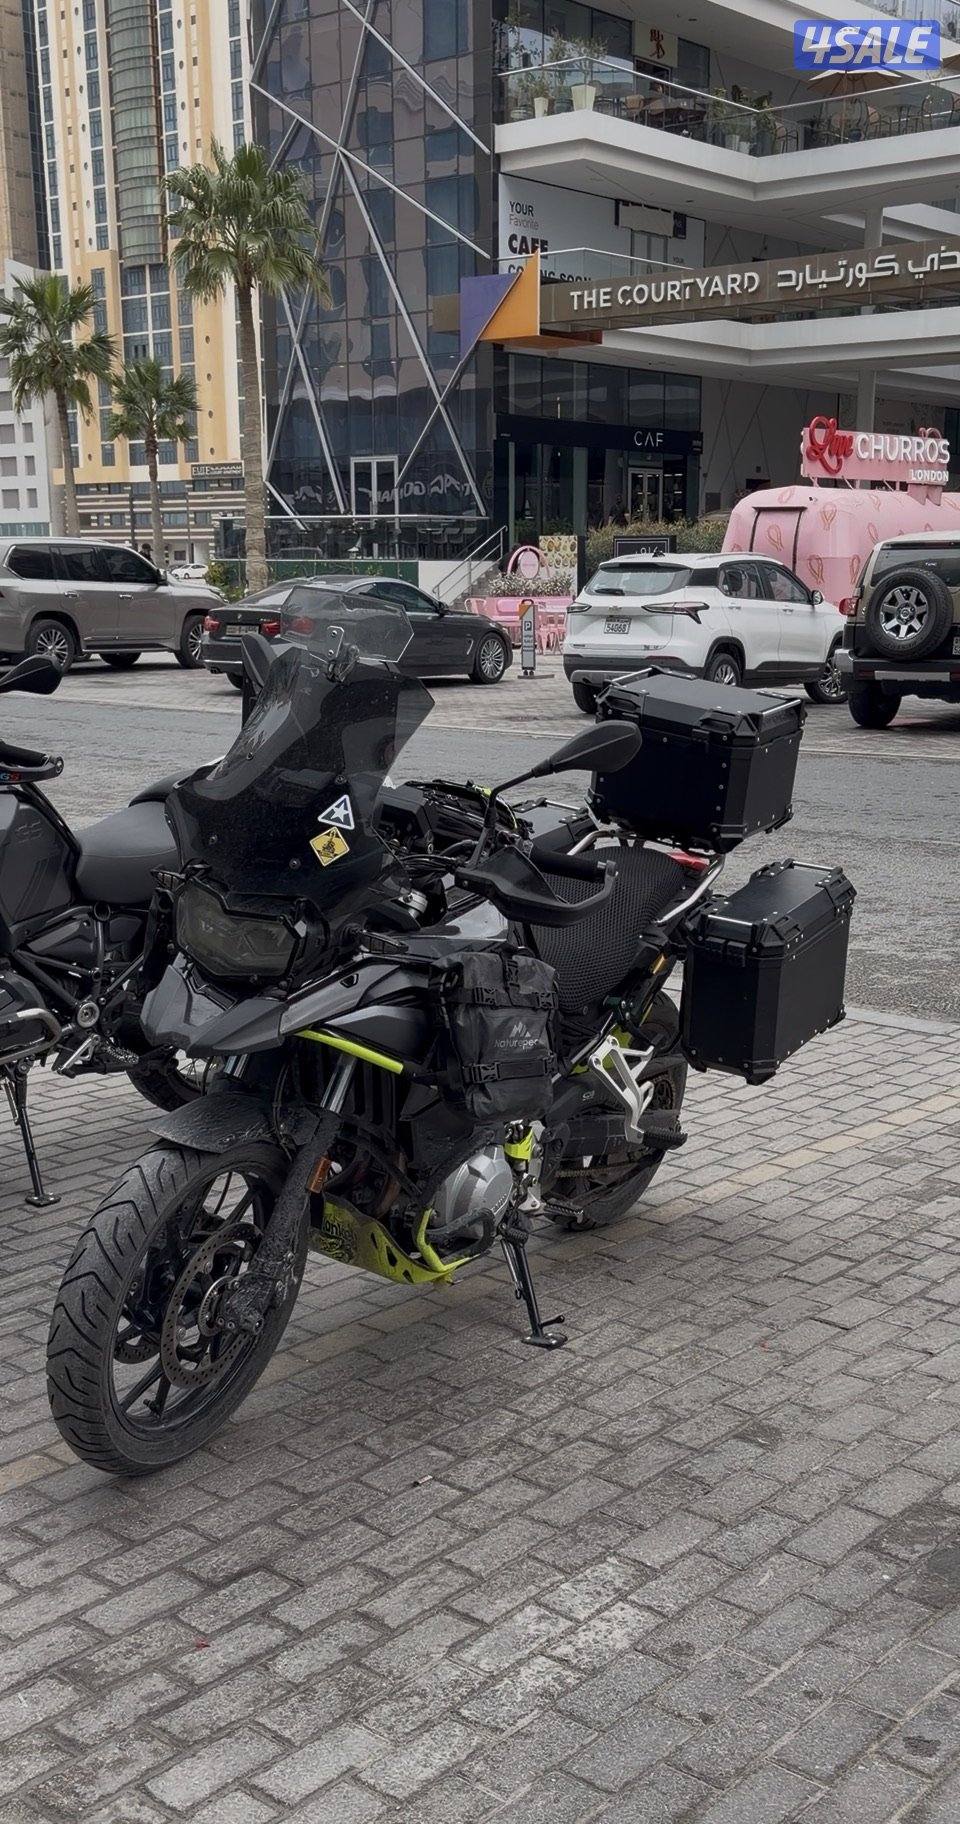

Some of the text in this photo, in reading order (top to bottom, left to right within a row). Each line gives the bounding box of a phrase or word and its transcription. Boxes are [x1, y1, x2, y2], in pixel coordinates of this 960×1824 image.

[509, 201, 534, 217] YOUR
[508, 233, 549, 260] CAFE
[777, 254, 900, 292] كورتيارد
[570, 271, 761, 311] THE COURTYARD
[857, 434, 950, 464] CHURROS
[911, 469, 949, 482] LONDON
